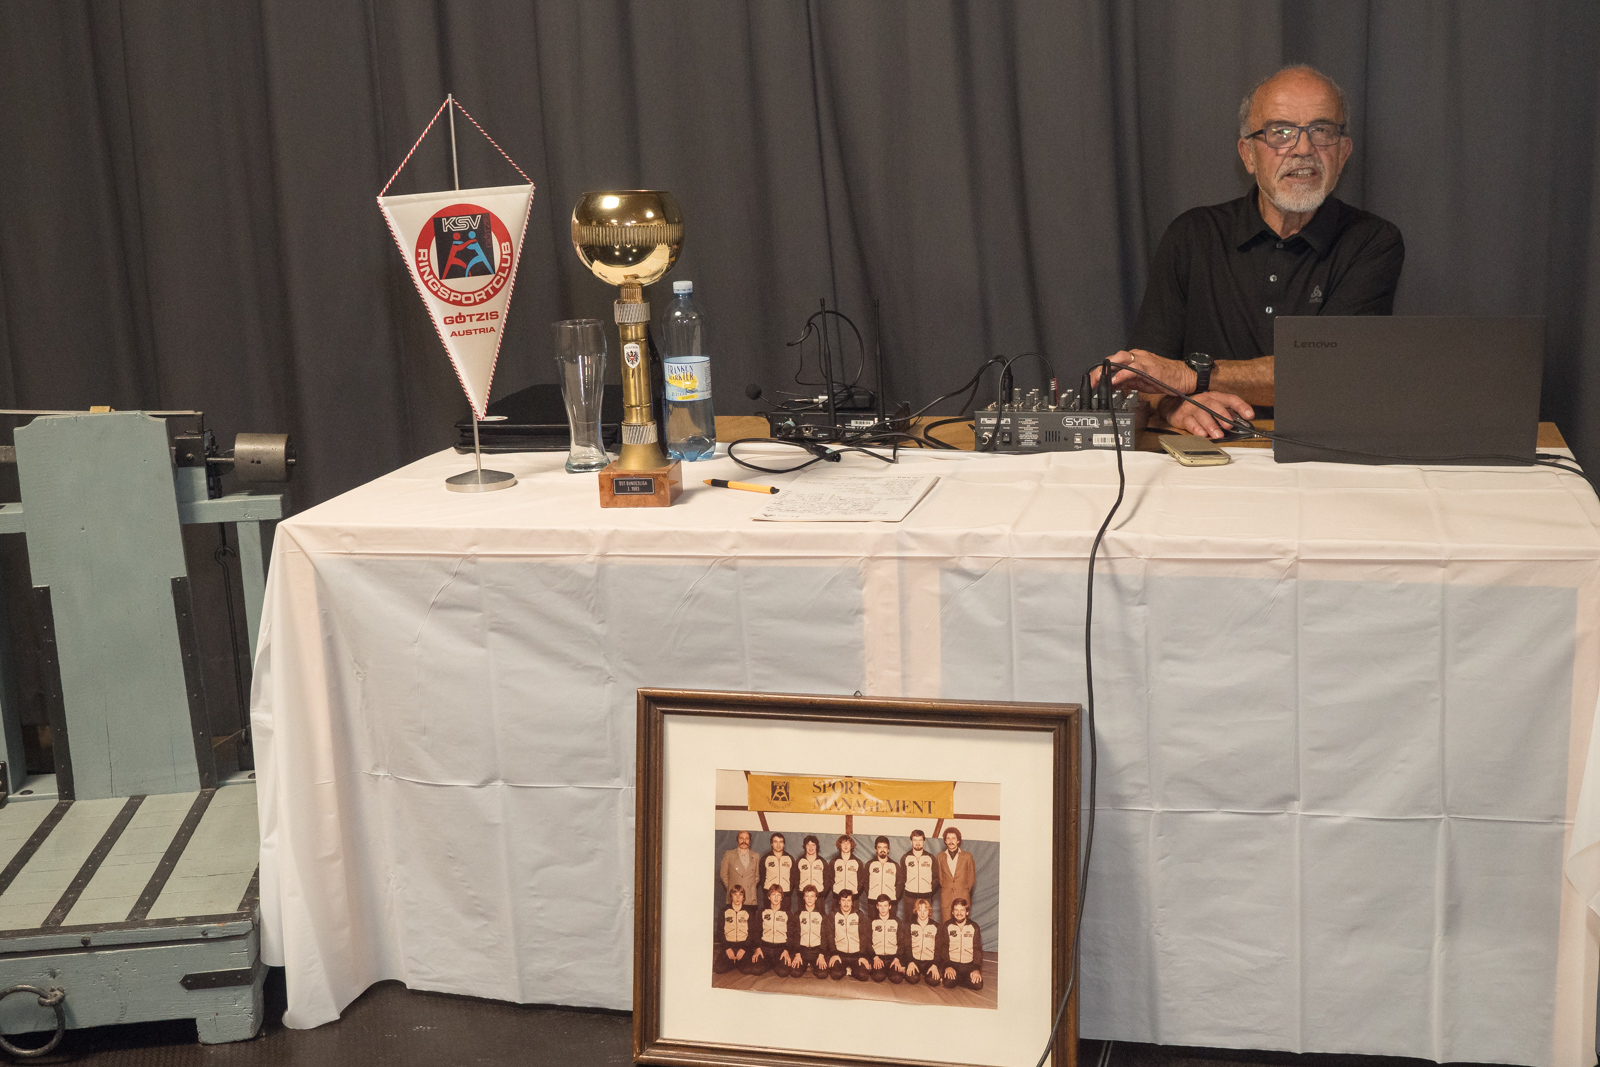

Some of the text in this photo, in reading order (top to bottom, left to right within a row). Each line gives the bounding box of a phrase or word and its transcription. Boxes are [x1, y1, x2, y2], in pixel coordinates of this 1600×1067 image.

[442, 215, 481, 232] KSV
[417, 241, 512, 304] RINGSPORTCLUB
[450, 326, 496, 337] AUSTRIA
[1293, 340, 1338, 348] Lenovo
[1065, 416, 1100, 428] SYNQ
[813, 797, 936, 814] MANAGEMENT
